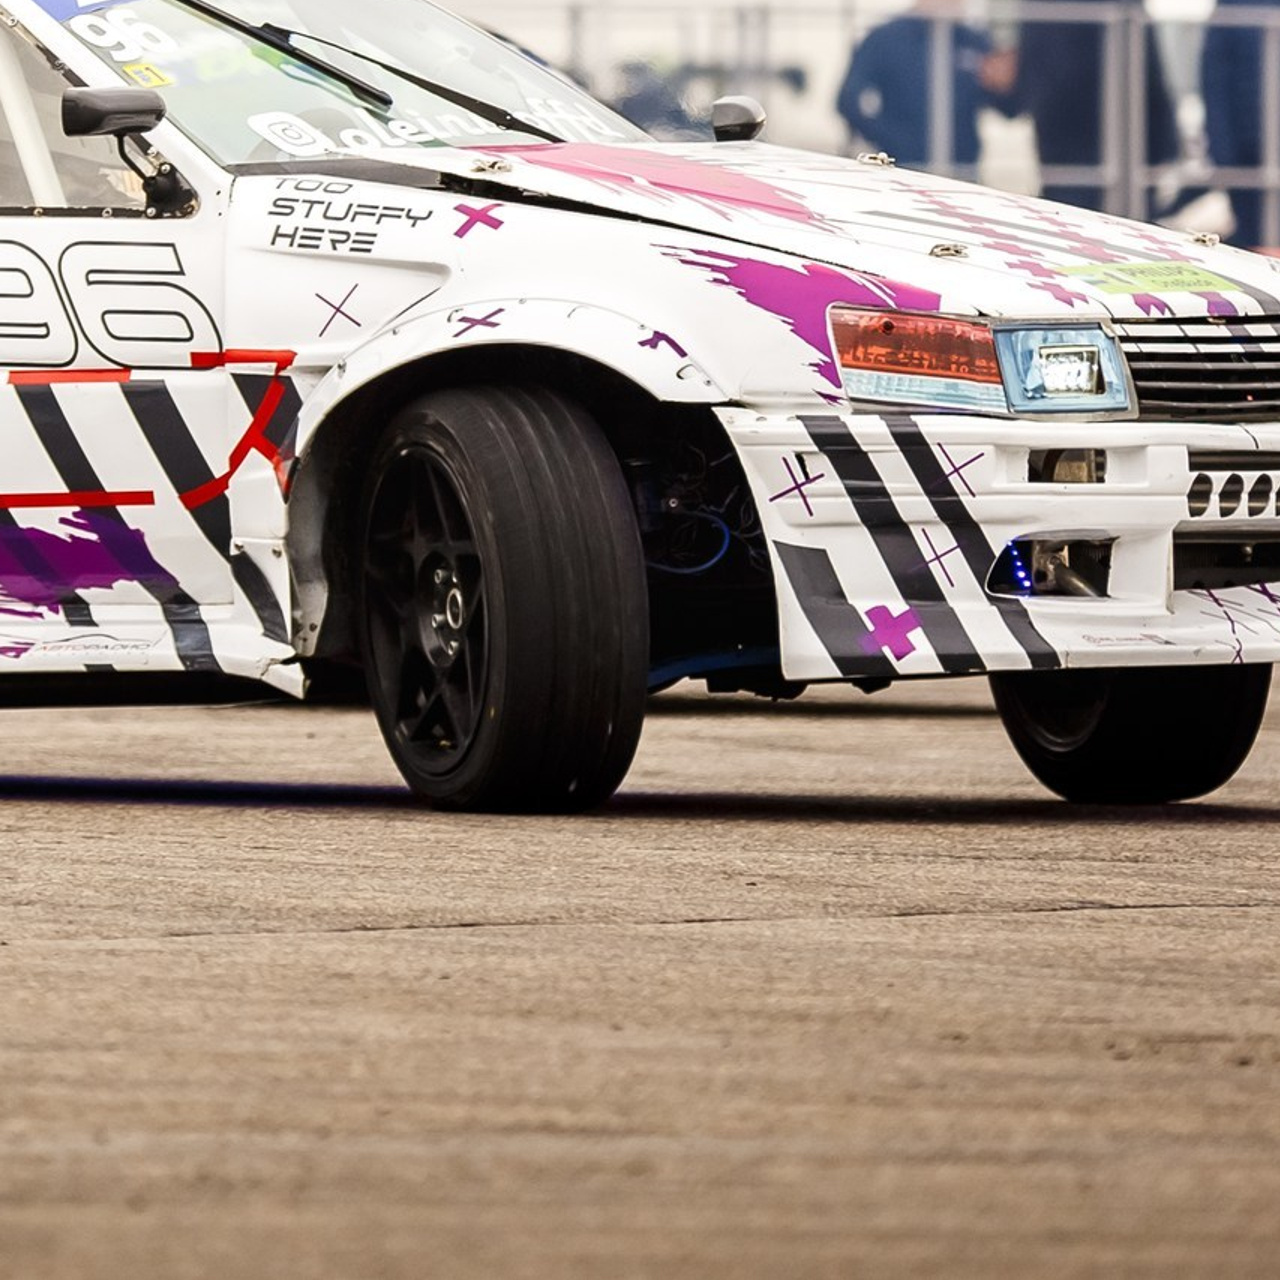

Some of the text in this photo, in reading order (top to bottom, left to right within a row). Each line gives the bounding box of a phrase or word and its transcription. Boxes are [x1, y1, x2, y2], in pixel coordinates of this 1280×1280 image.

[70, 9, 179, 62] 96
[276, 177, 354, 195] TOO
[268, 198, 433, 228] STUFFY
[270, 225, 378, 253] HERE
